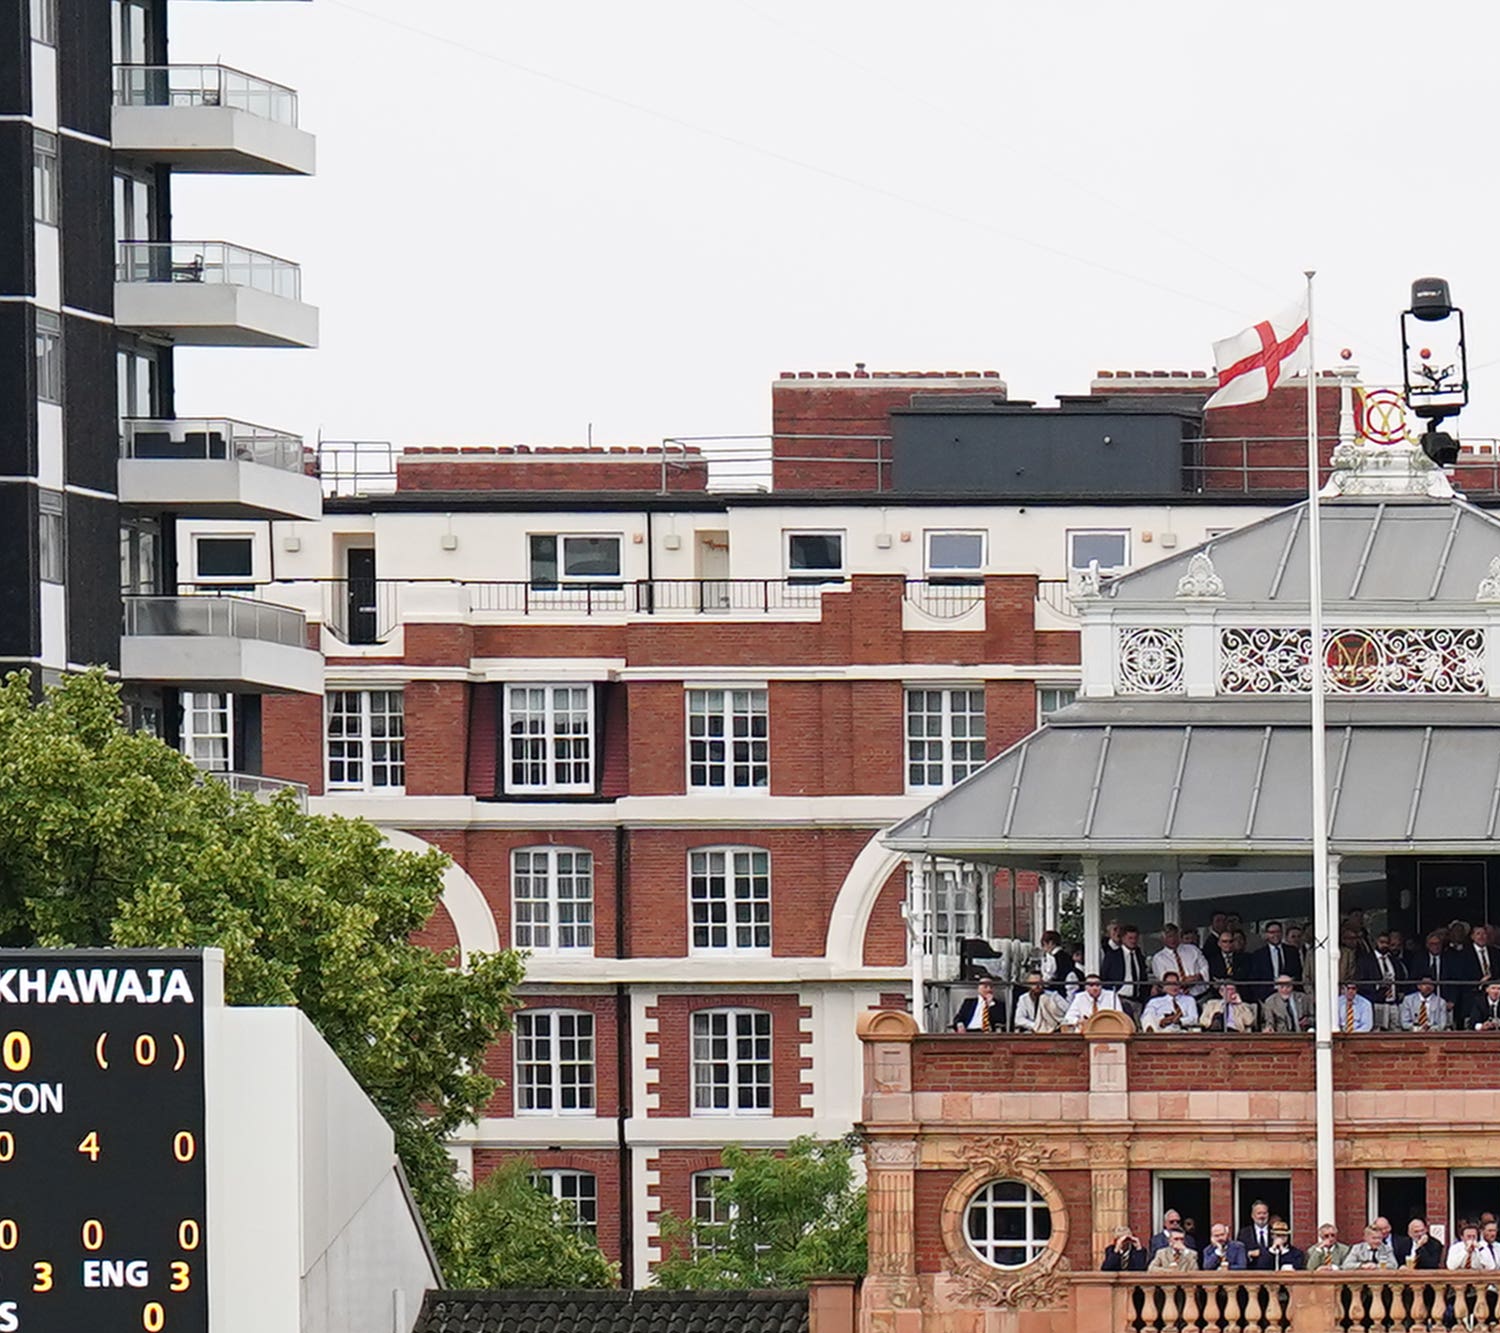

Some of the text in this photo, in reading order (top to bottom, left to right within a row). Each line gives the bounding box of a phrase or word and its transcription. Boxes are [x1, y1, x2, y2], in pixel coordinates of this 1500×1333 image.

[0, 969, 194, 1003] KHAWAJA
[3, 1032, 30, 1071] 0
[136, 1035, 155, 1065] 0
[0, 1132, 194, 1161] 0 4 0
[0, 1220, 198, 1250] 0 0 0
[33, 1261, 189, 1292] 3 ENG 3
[0, 1302, 164, 1332] S 0
